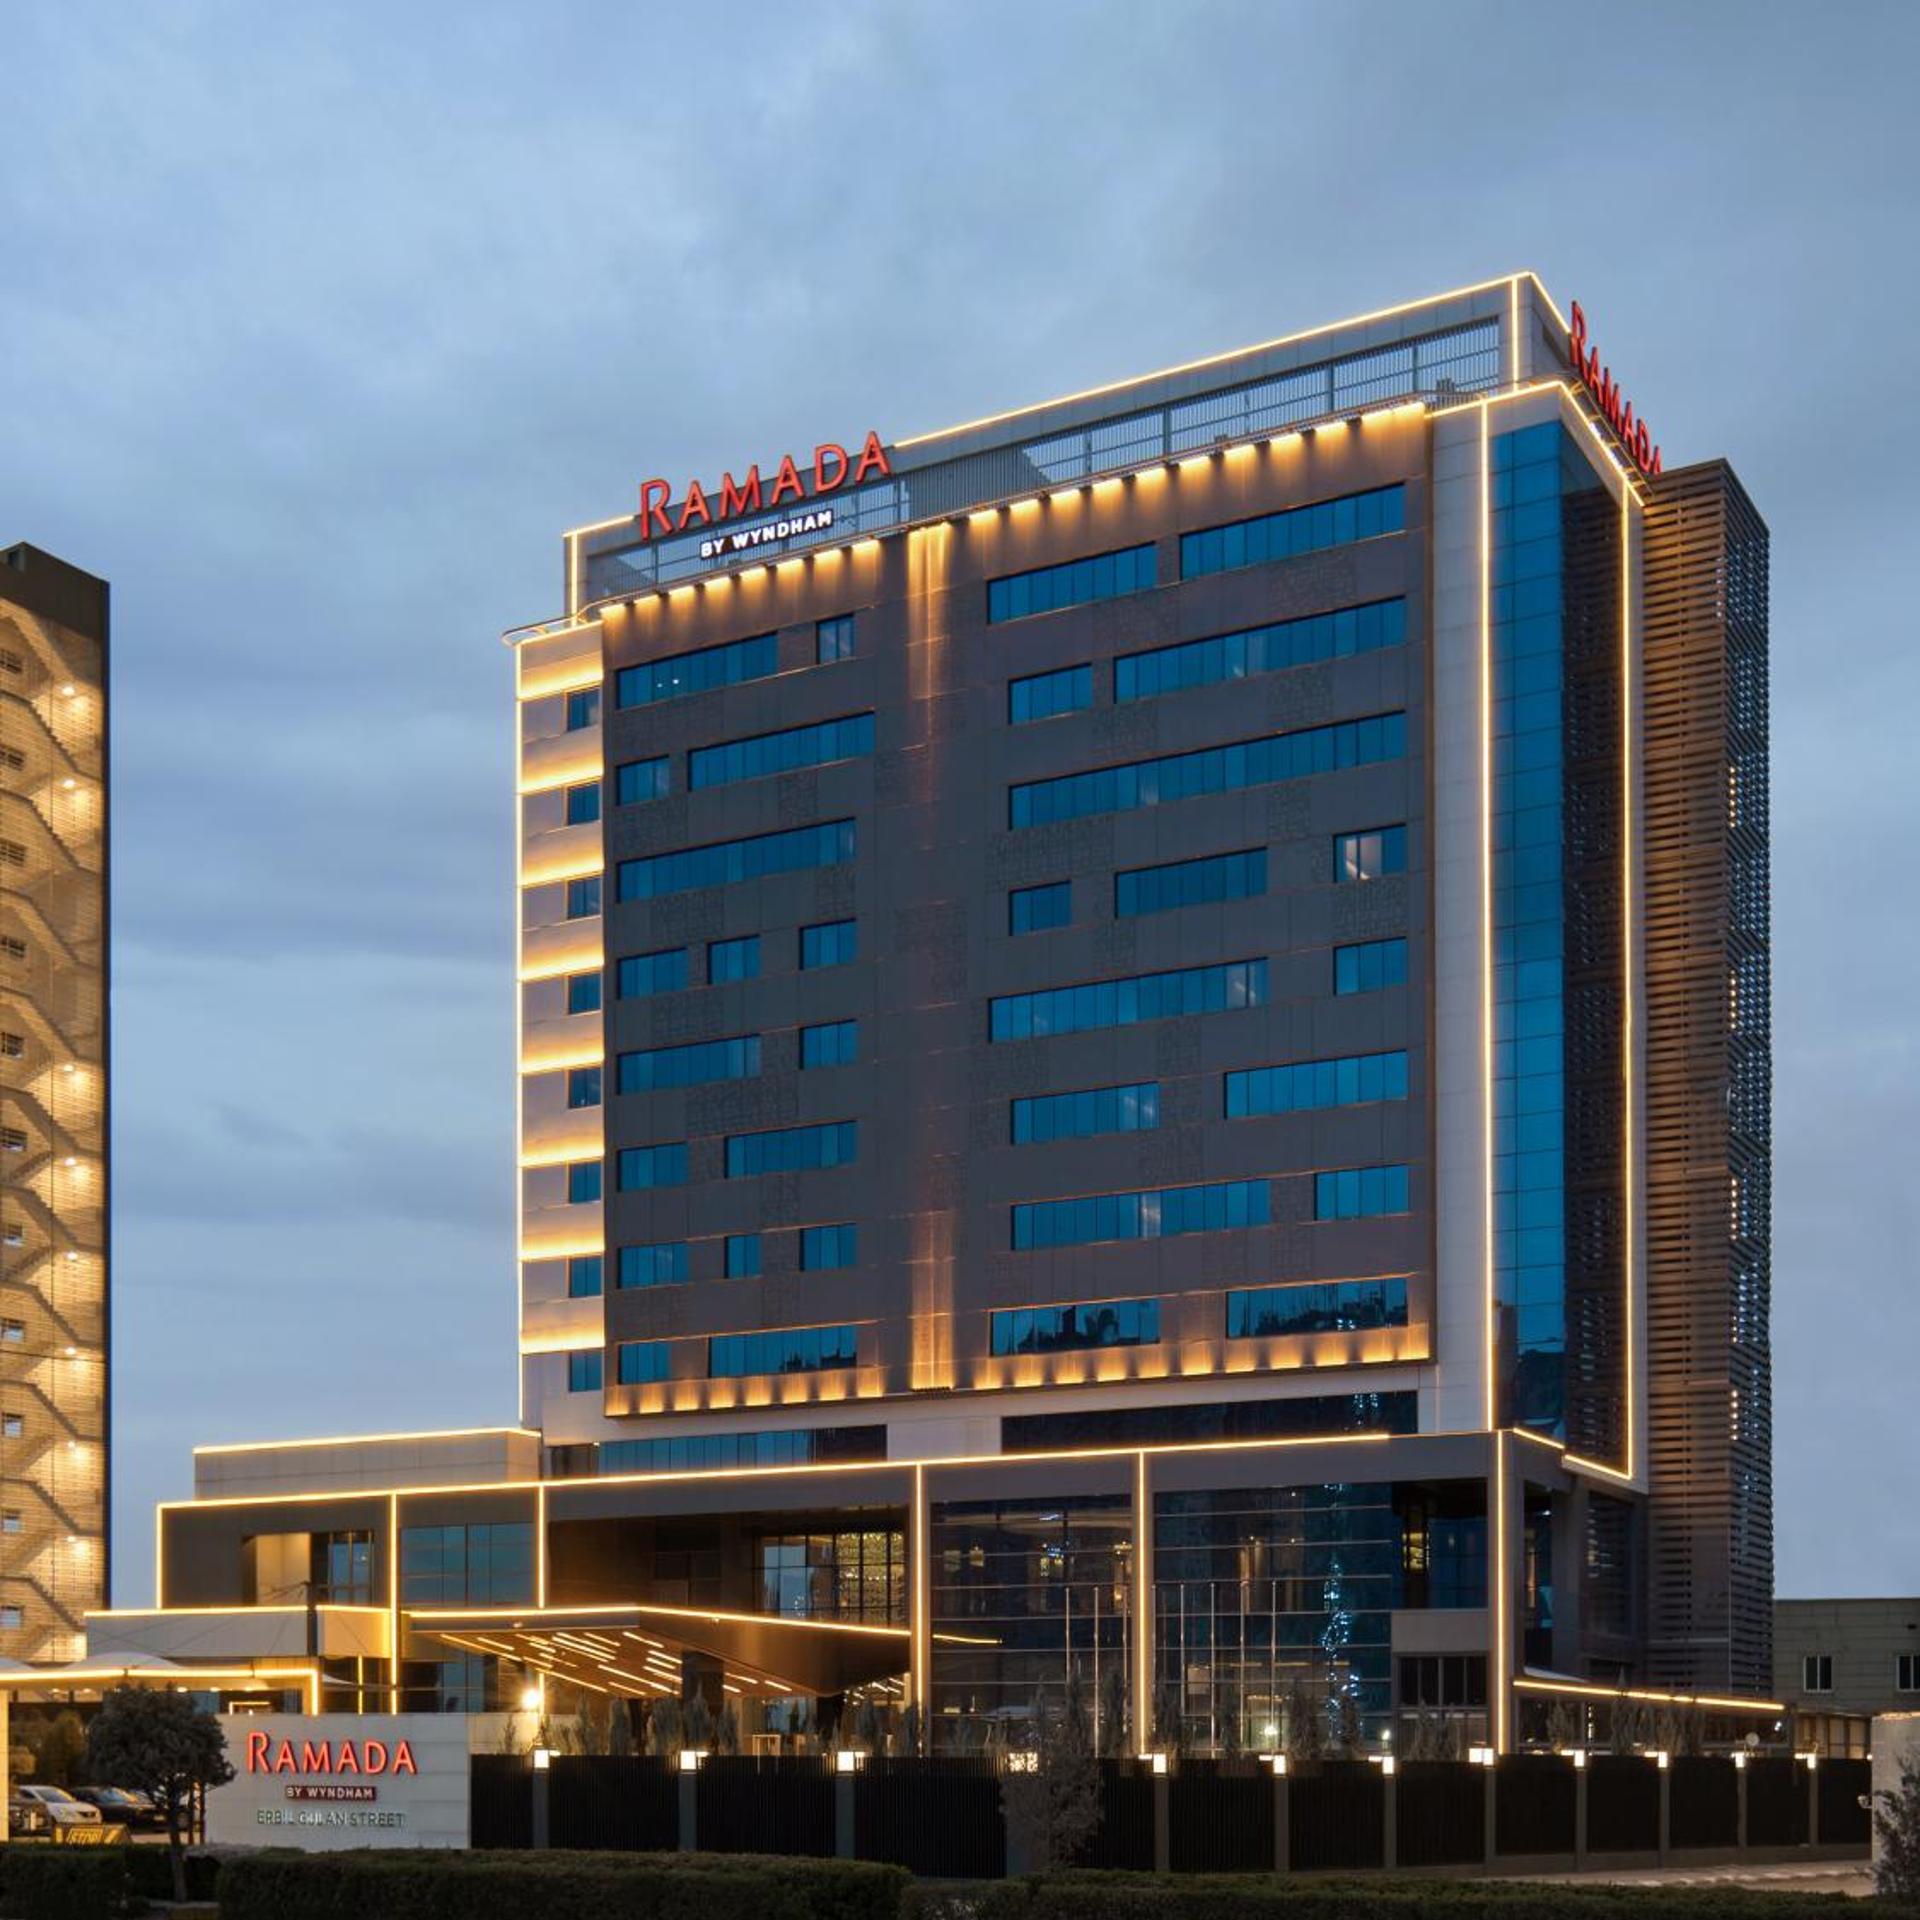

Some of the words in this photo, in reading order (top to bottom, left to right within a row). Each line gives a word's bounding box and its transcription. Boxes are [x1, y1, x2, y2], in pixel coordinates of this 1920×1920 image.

[640, 430, 891, 540] RAMADA
[701, 538, 725, 558] BY
[732, 510, 833, 549] WYNDHAM
[246, 1731, 418, 1775] RAMADA
[286, 1787, 301, 1798] BY
[307, 1788, 373, 1798] WYNDHAM
[349, 1812, 405, 1827] STREET
